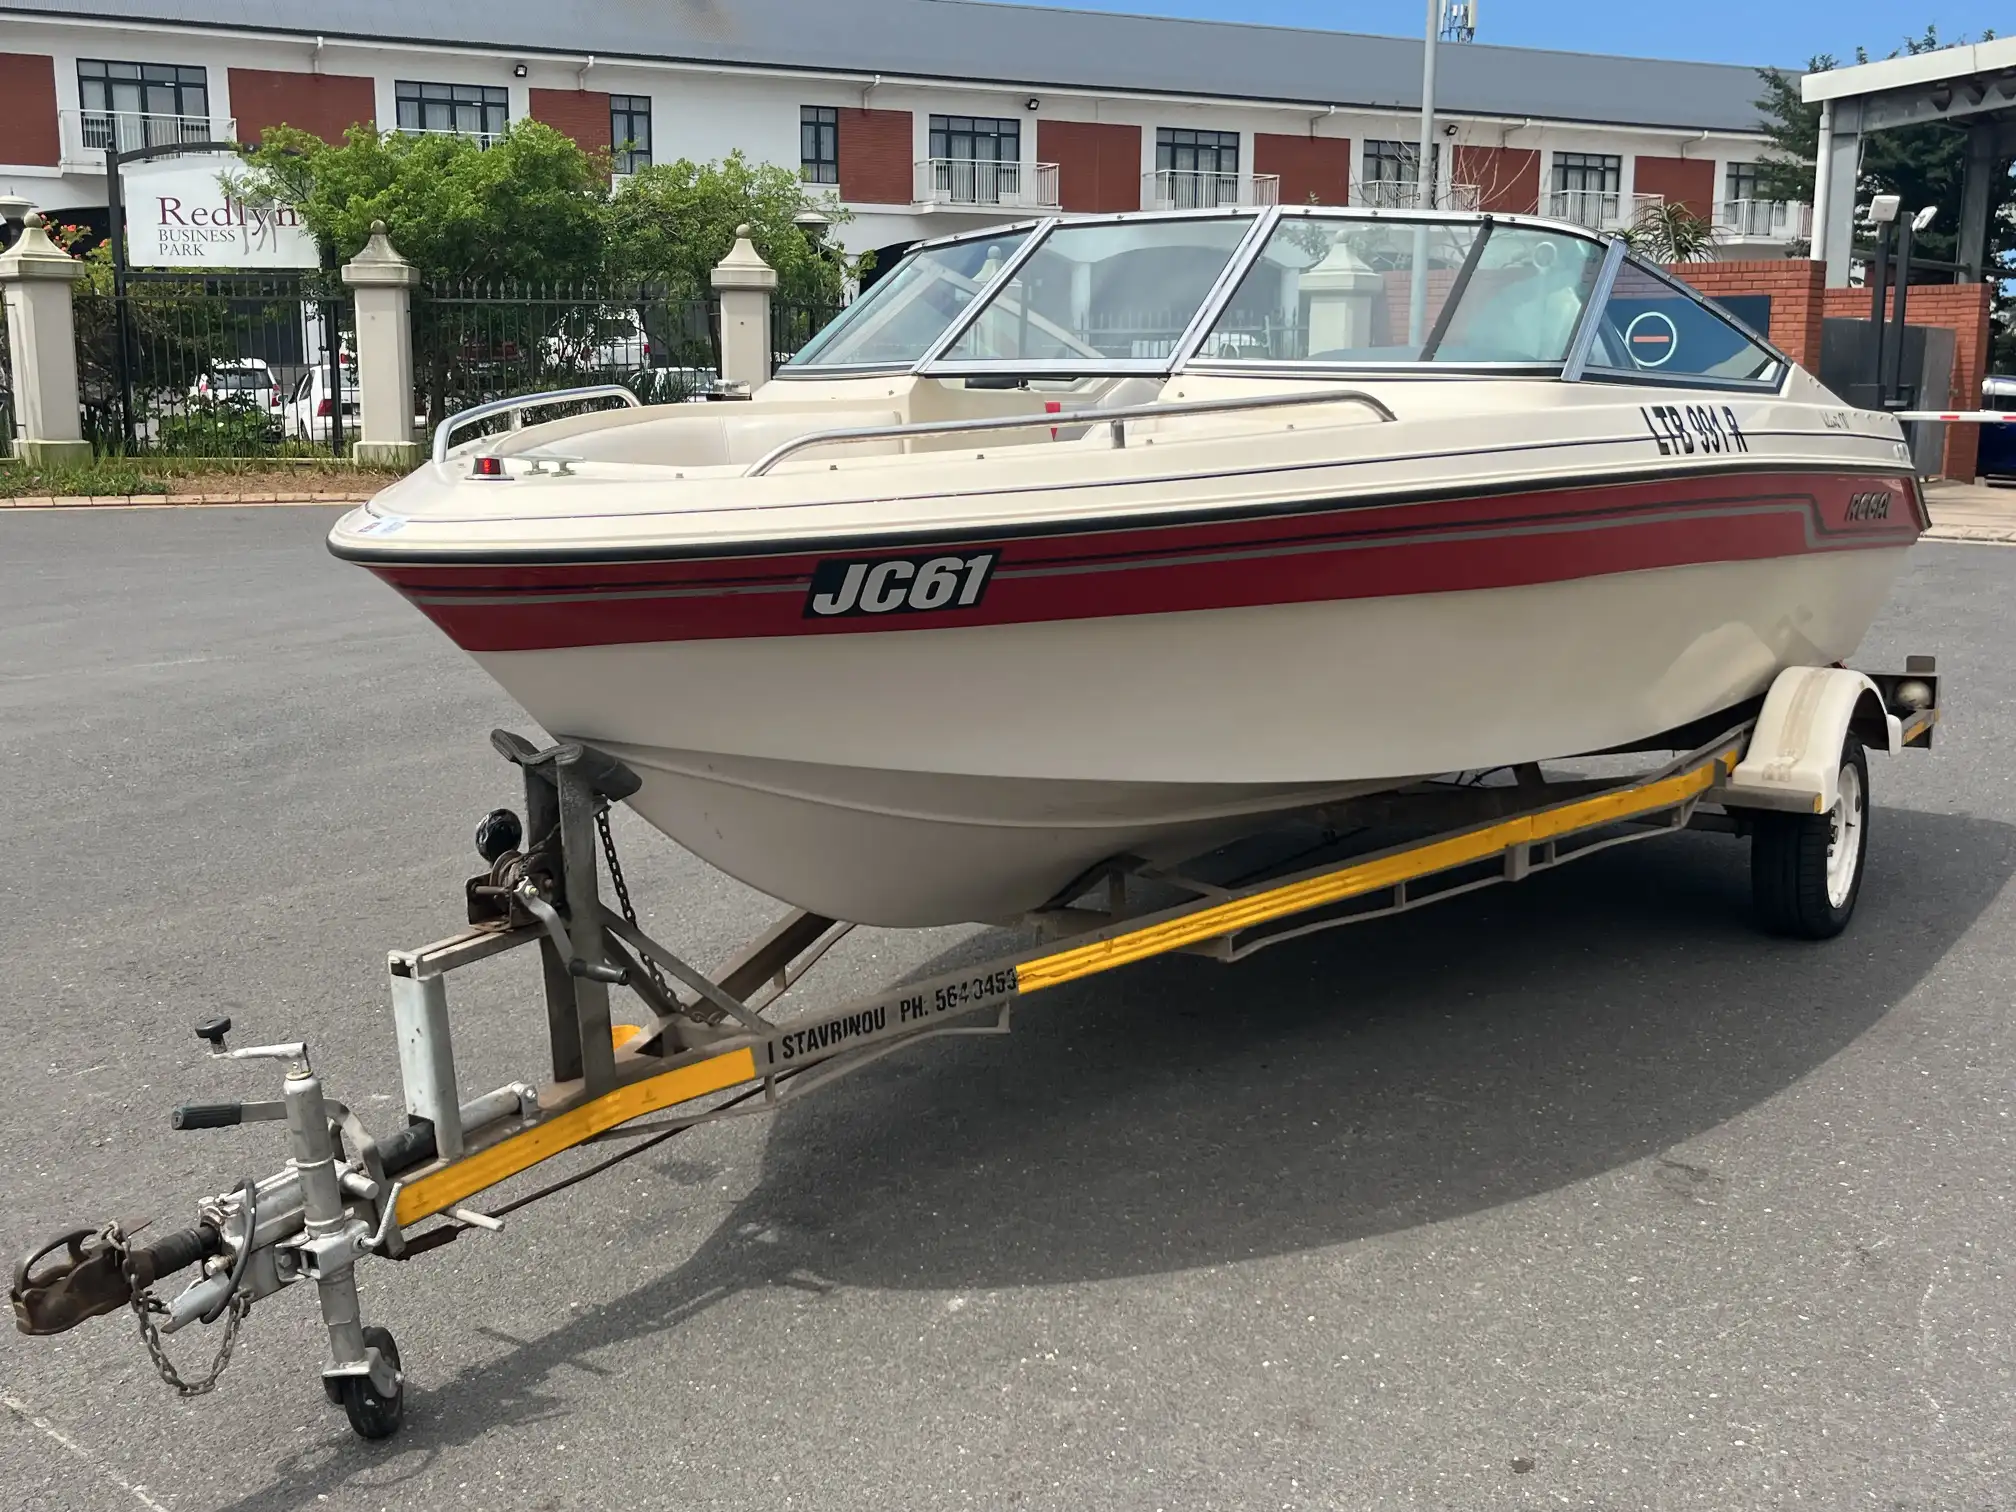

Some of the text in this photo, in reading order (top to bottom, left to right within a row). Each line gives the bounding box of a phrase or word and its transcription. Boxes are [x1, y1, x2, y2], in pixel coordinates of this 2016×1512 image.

[156, 195, 299, 236] Redlyn
[158, 229, 236, 243] BUSINESS
[159, 243, 205, 256] PARK
[1640, 405, 1694, 456] LTB
[812, 554, 993, 615] JC61
[782, 1006, 886, 1059] STAVRINOU
[900, 994, 929, 1023] PH.
